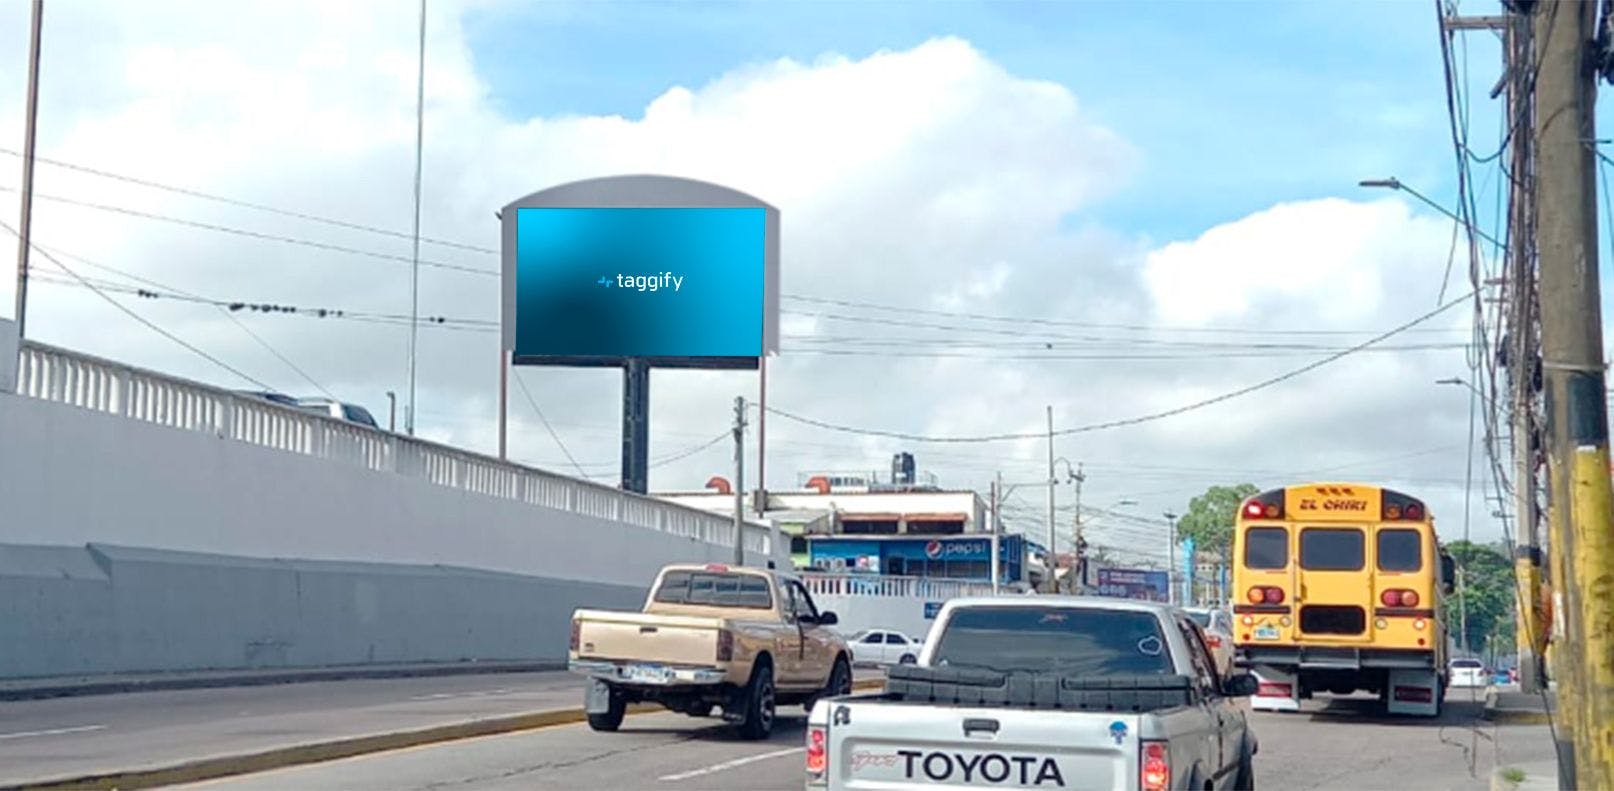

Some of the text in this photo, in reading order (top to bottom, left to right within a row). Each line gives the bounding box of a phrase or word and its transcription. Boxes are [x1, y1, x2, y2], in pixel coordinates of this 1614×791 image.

[616, 271, 684, 292] taggify
[945, 540, 986, 555] pepsi
[897, 750, 1065, 787] TOYOTA
